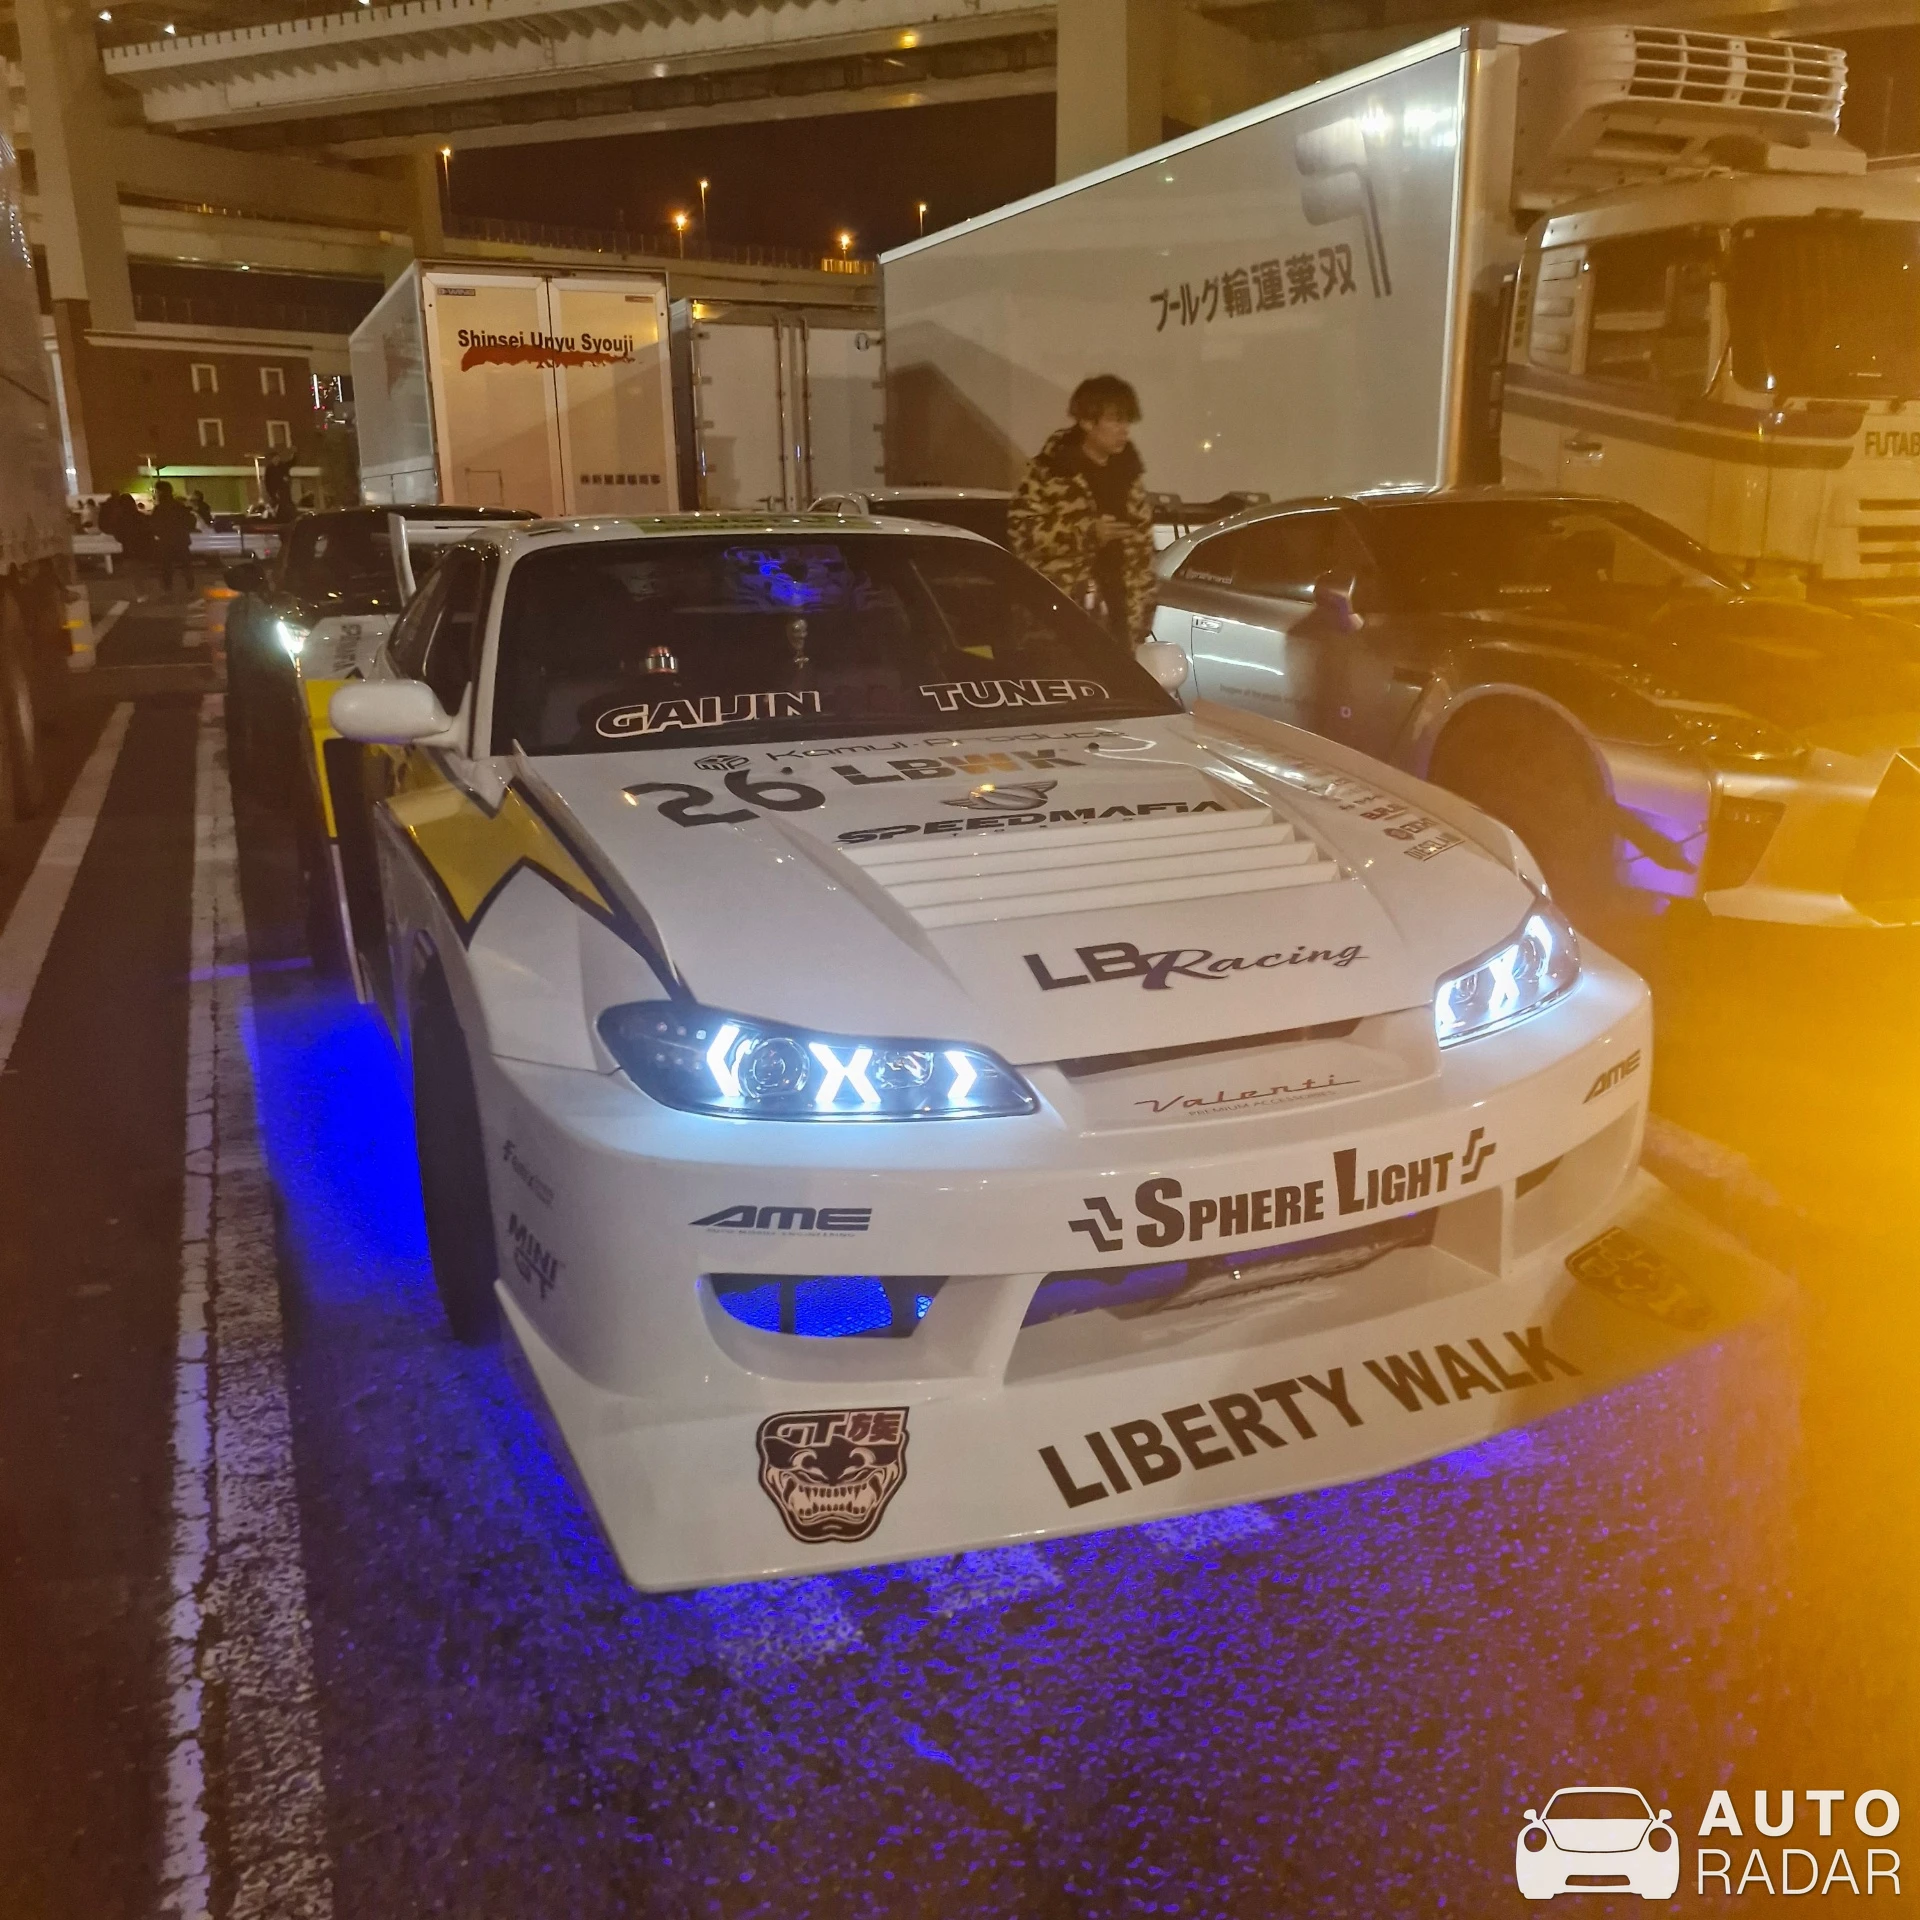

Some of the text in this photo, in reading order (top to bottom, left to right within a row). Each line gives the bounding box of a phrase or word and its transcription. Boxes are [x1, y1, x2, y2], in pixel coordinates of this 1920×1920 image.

[458, 329, 634, 356] Shinsei Unyu Syouji
[595, 679, 1110, 738] GAIJIN TUNED
[831, 748, 1087, 786] LBWK
[621, 769, 826, 827] 26
[836, 800, 1227, 844] SPEEDMAFIA
[1134, 1074, 1360, 1113] Valenti
[1582, 1048, 1641, 1104] AME
[688, 1205, 872, 1231] AME
[508, 1213, 559, 1284] MINI
[1038, 1326, 1583, 1509] LIBERTY WALK
